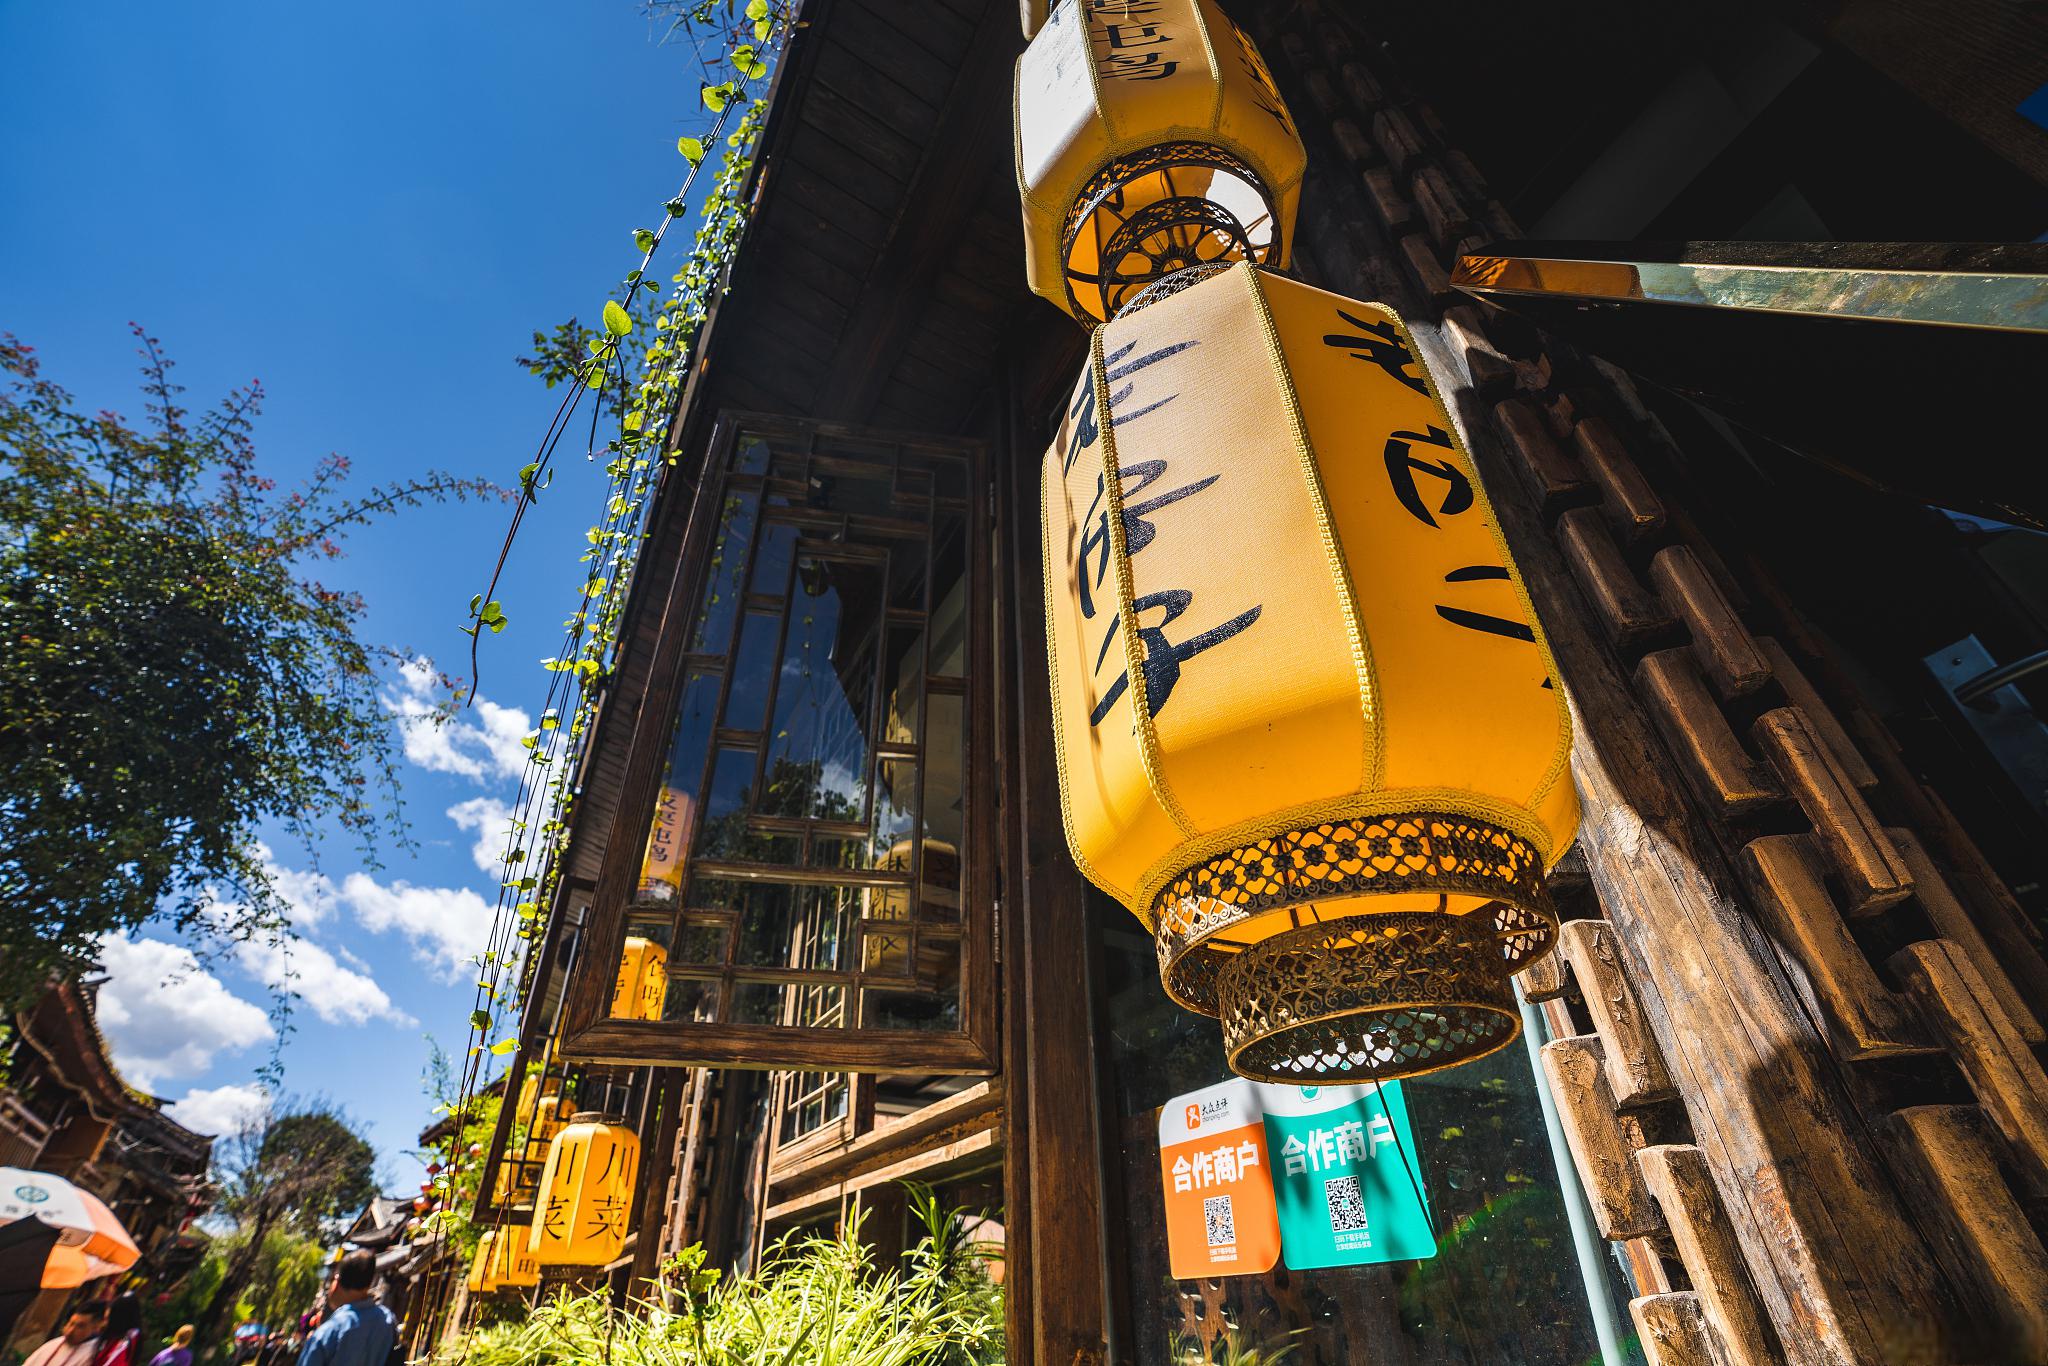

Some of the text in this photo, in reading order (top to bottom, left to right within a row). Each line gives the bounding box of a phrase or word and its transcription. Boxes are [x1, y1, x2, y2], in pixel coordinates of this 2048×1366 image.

[1201, 1097, 1229, 1116] 大众点评
[1171, 1140, 1260, 1194] 合作商户
[1280, 1113, 1396, 1177] 合作商户
[586, 1142, 635, 1241] 川菜
